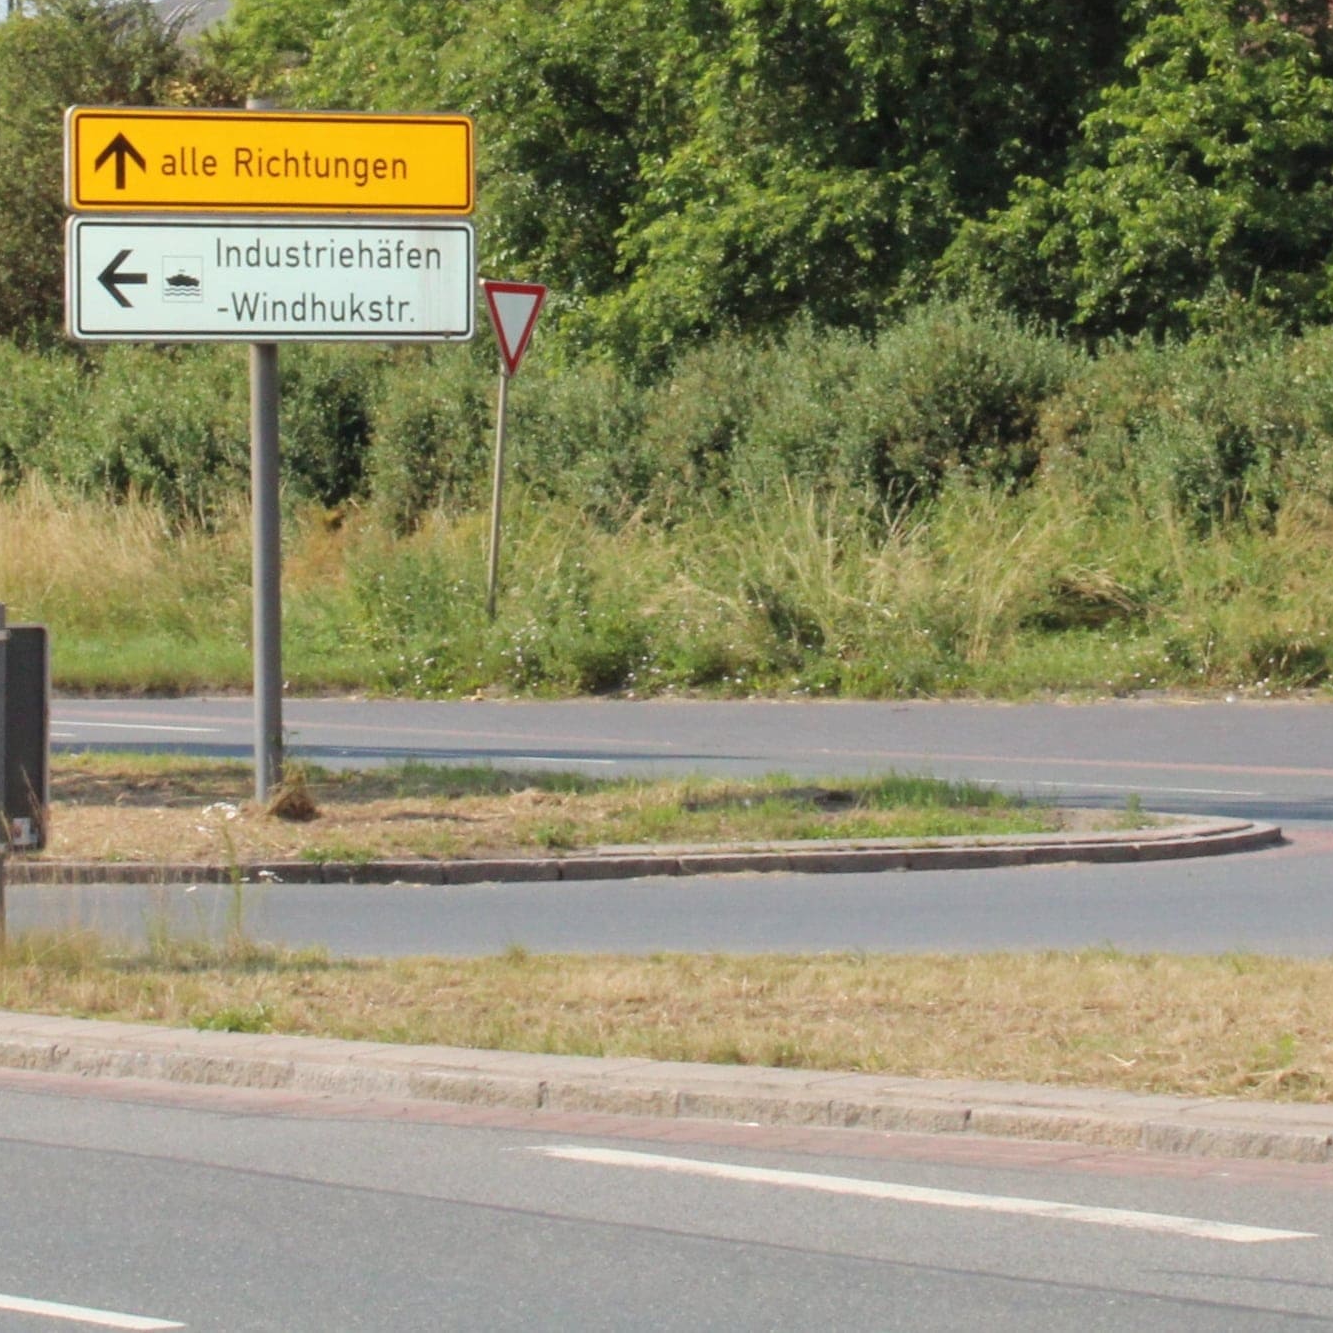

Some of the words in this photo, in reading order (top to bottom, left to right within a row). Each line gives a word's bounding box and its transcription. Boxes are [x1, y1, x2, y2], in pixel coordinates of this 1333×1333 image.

[161, 146, 217, 176] alle
[234, 147, 408, 187] Richtungen
[216, 237, 441, 269] Industriehäfen
[217, 291, 415, 322] -Windhukstr.
